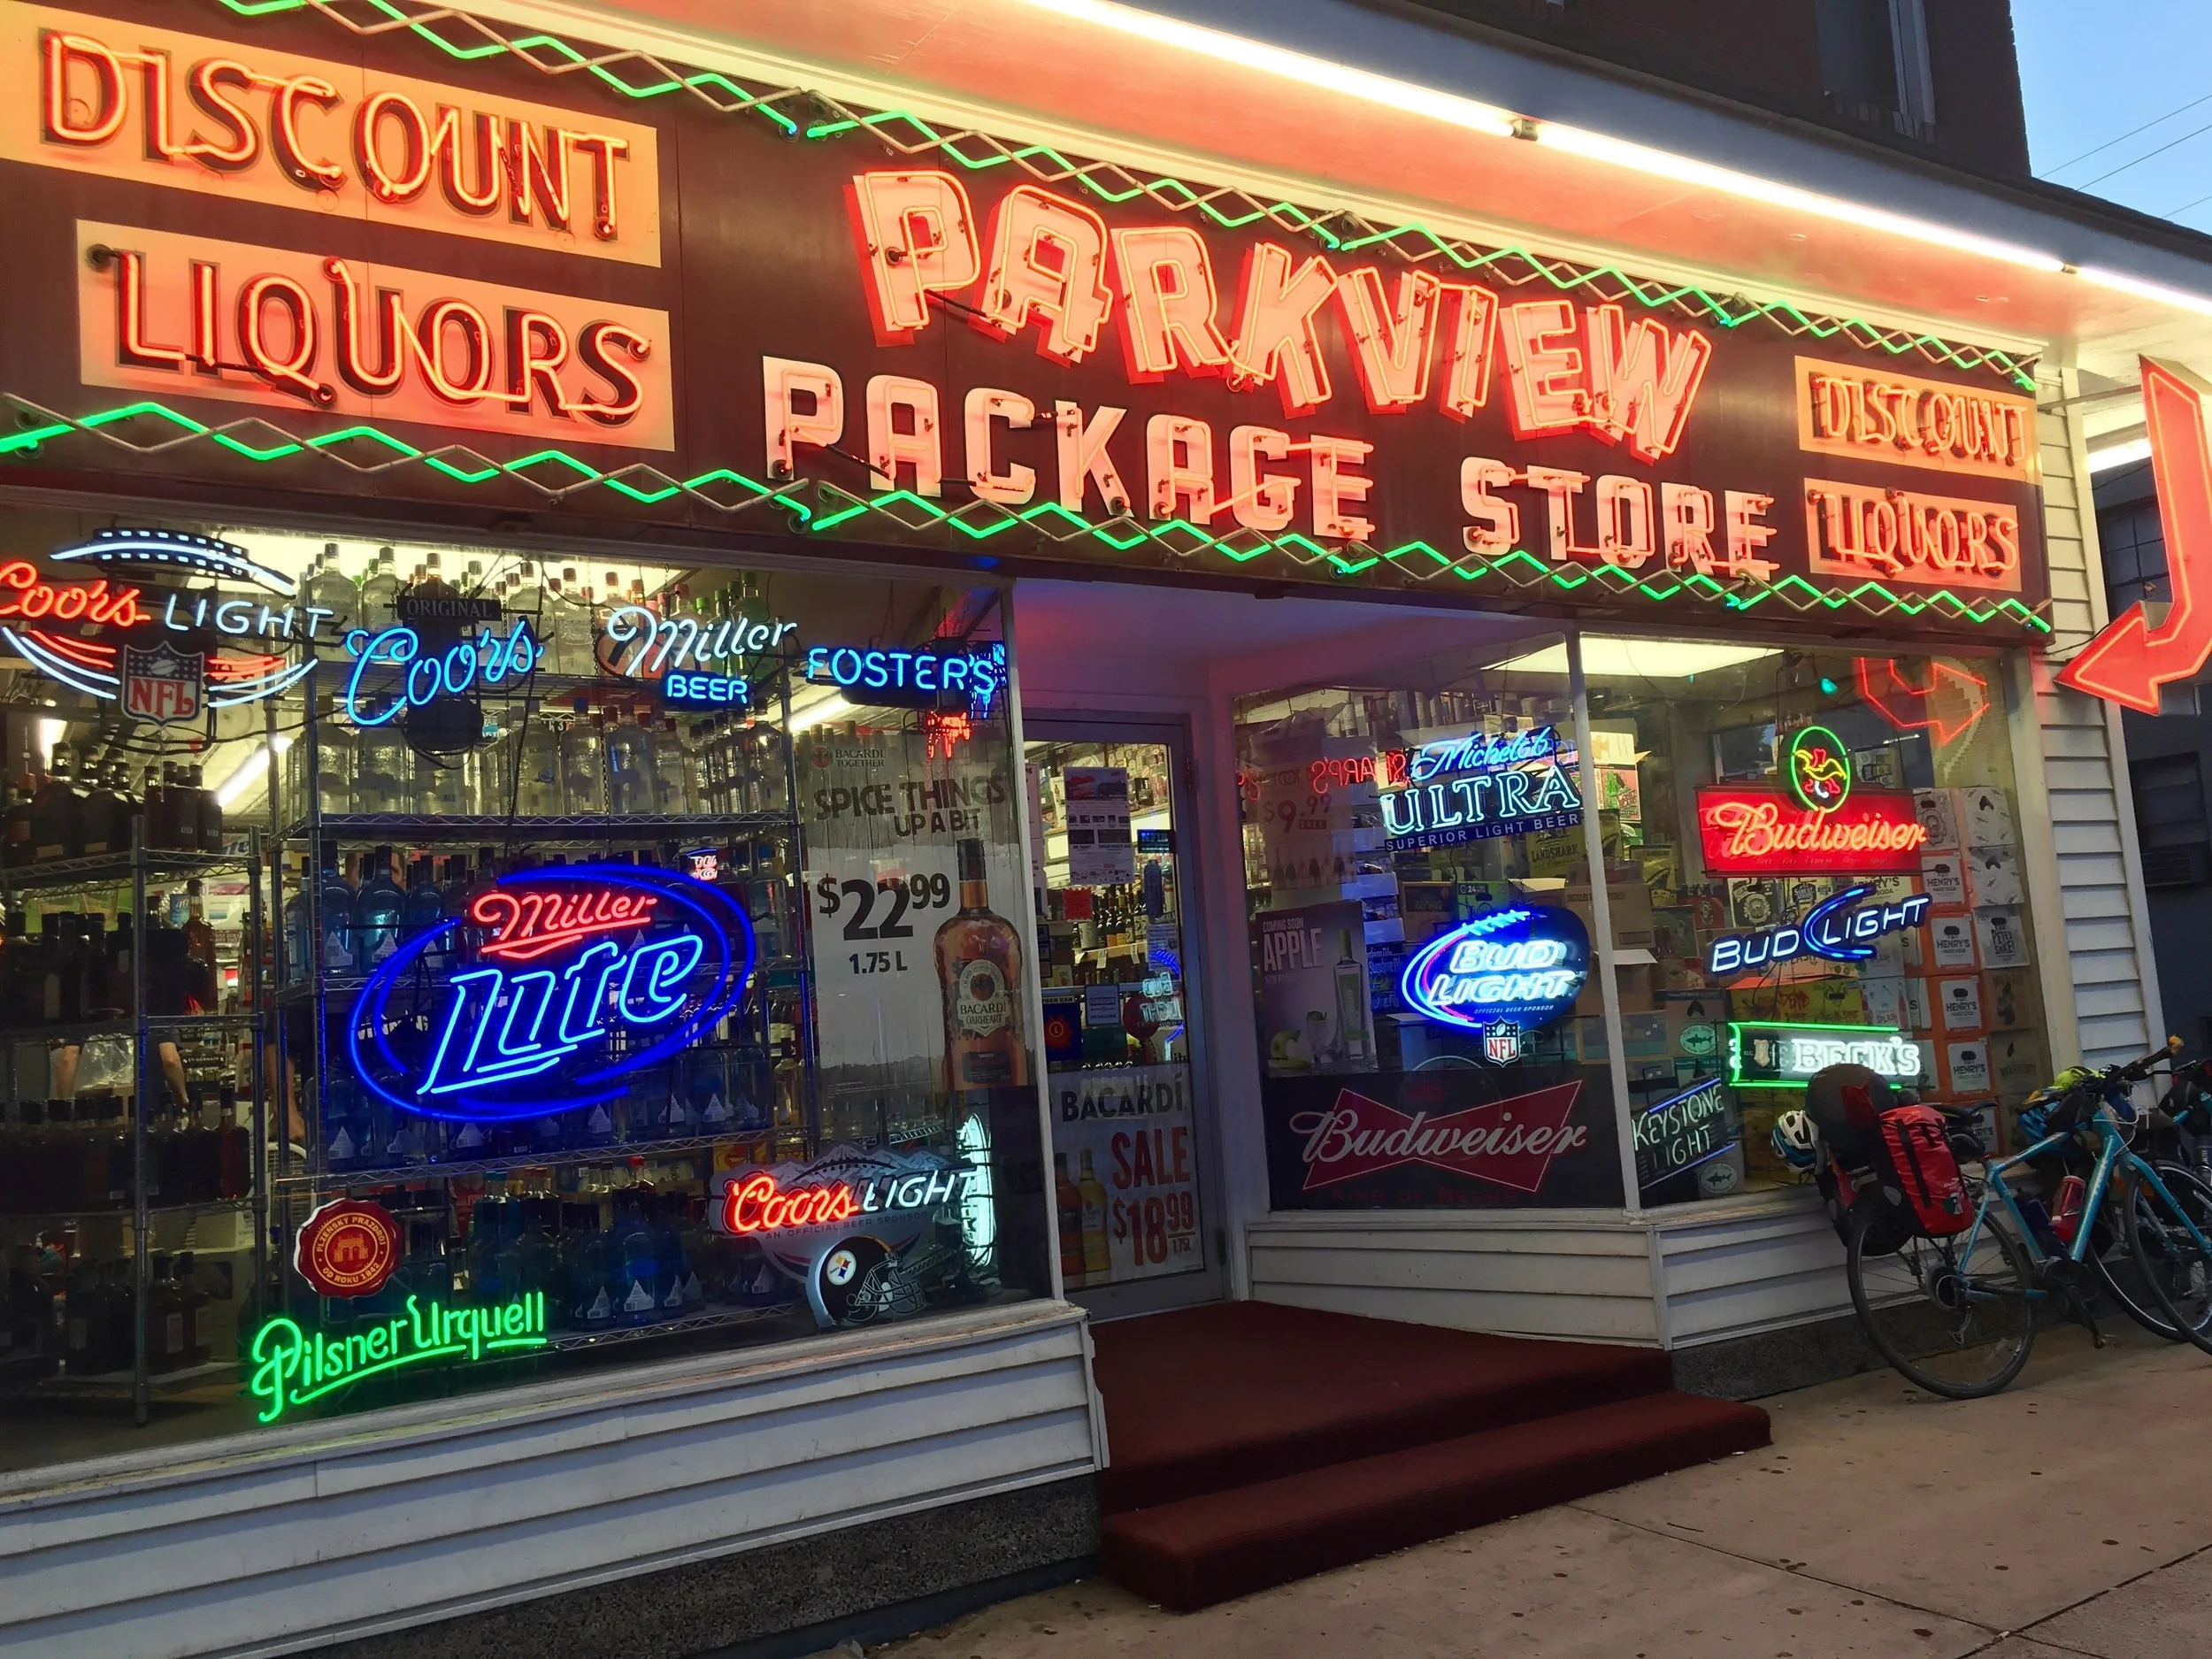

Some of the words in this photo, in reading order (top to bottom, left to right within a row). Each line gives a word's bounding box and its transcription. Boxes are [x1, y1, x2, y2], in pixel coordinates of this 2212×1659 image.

[40, 29, 630, 241] DISCOUNT
[114, 251, 653, 427] LIQUORS
[843, 170, 1711, 465] PARKVIEW
[1809, 373, 2029, 466] DISCOUNT
[763, 356, 1374, 541] PACKAGE
[1461, 457, 1780, 580] STORE
[1815, 489, 2019, 577] LIQUORS
[165, 594, 334, 637] LIGHT
[406, 599, 493, 618] ORIGINAL
[607, 606, 796, 677] Miller
[667, 674, 749, 704] BEER
[807, 647, 995, 695] FOSTER'S
[129, 679, 196, 718] NFL
[1410, 726, 1552, 781] Michelob
[814, 784, 895, 820] SPICE
[899, 775, 1005, 811] THINGS
[1380, 764, 1580, 836] ULTRA
[895, 814, 926, 837] UP
[931, 811, 946, 833] A
[949, 809, 981, 831] BIT
[1386, 829, 1467, 850] SUPERIOR
[1476, 821, 1523, 840] LIGHT
[1533, 813, 1579, 830] BEER
[1715, 802, 1929, 856] Budweiser
[1532, 844, 1578, 863] LANDSHARK
[1927, 878, 1961, 887] HENRY'S
[472, 892, 657, 941] Miller
[1263, 919, 1286, 933] COMING
[1287, 918, 1304, 929] SOON
[1712, 930, 1800, 973] BUD
[1823, 897, 1929, 944] LIGHT
[849, 951, 890, 974] 1.75
[895, 950, 908, 971] L
[1263, 927, 1323, 972] APPLE
[1449, 940, 1563, 973] BUD
[1937, 939, 1970, 949] HENRY'S
[1428, 970, 1576, 1006] LIGHT
[1946, 1002, 1978, 1011] HENRY'S
[417, 934, 703, 1094] Lite
[1488, 1039, 1517, 1060] NFL
[1791, 1036, 1921, 1076] BECK'S
[1953, 1064, 1986, 1074] HENRY'S
[1289, 1110, 1588, 1164] Budweiser
[1632, 1083, 1724, 1151] KEYSTONE
[1111, 1126, 1191, 1190] SALE
[733, 1175, 859, 1232] Coors
[863, 1170, 983, 1212] LIGHT
[787, 1225, 839, 1237] OFFICIAL
[843, 1219, 872, 1229] BEER
[878, 1211, 929, 1225] SPONSOR
[334, 1274, 359, 1284] ROKU
[361, 1262, 381, 1279] 1842
[252, 1318, 408, 1423] Pilsner
[407, 1292, 544, 1361] Urquell
